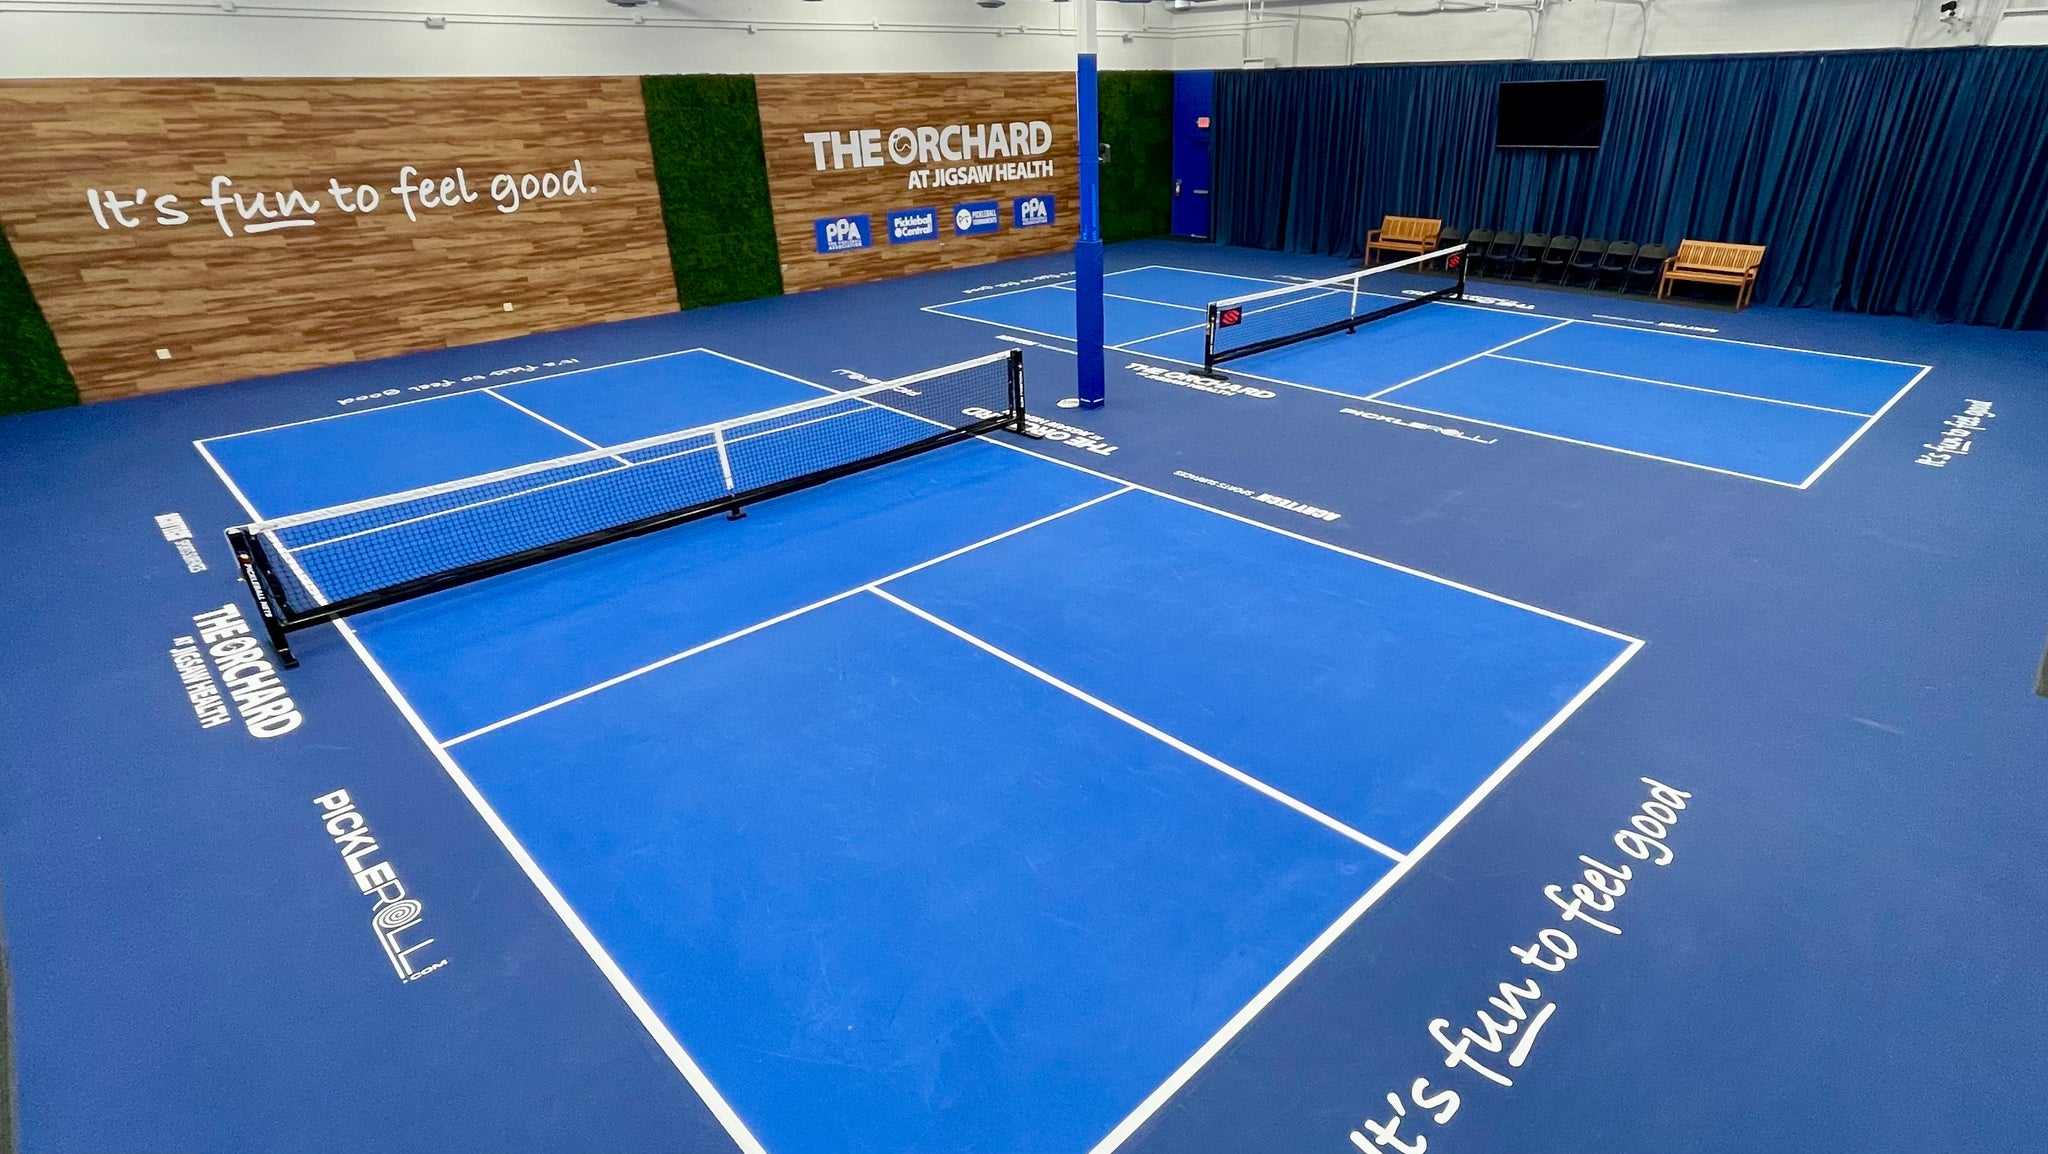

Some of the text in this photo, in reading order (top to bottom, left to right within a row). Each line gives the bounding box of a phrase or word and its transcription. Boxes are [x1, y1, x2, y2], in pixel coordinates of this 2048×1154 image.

[804, 120, 1052, 171] THE ORCHARD
[908, 160, 1054, 190] AT JIGSAW HEALTH
[86, 159, 598, 237] It's fun to feel good.
[1021, 197, 1047, 219] PPA
[826, 218, 861, 242] PPA
[894, 213, 932, 228] Pickleball
[337, 388, 401, 406] good
[1125, 362, 1276, 399] THE ORCHARD
[1063, 436, 1119, 456] THE
[1218, 482, 1255, 496] SPORTS
[170, 635, 232, 729] AT JIGSAW HEALTH
[192, 603, 303, 739] THE ORCHARD
[313, 788, 434, 979] PICKLEROLL
[1349, 776, 1692, 1154] It's fun to feel good
